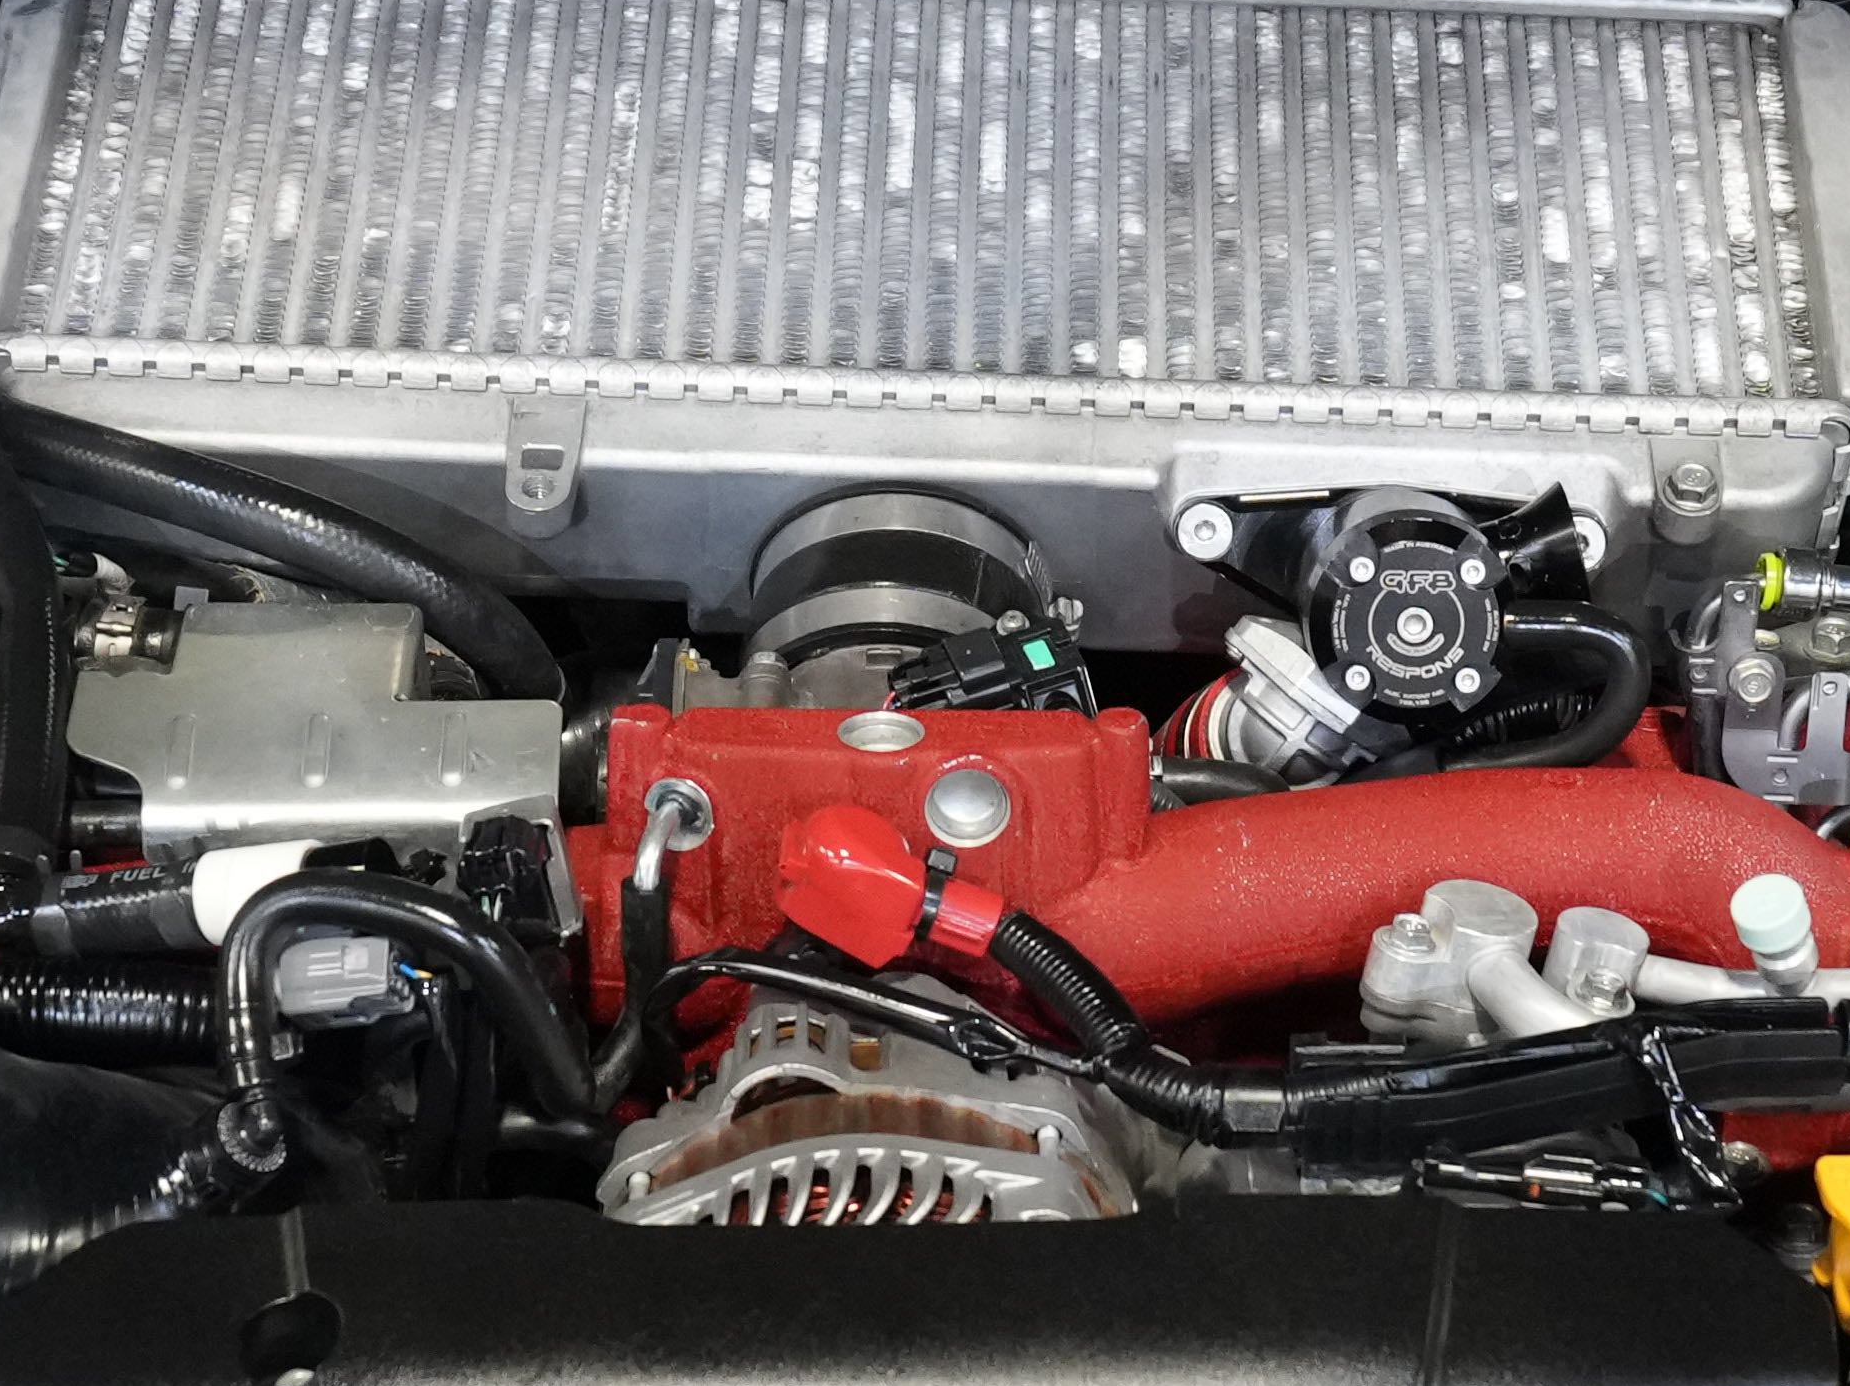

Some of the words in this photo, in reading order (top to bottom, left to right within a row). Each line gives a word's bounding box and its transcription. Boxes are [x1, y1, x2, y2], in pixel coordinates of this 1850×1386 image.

[1380, 570, 1456, 594] GFB
[1366, 645, 1464, 679] RESPONS
[109, 867, 166, 884] FUEL
